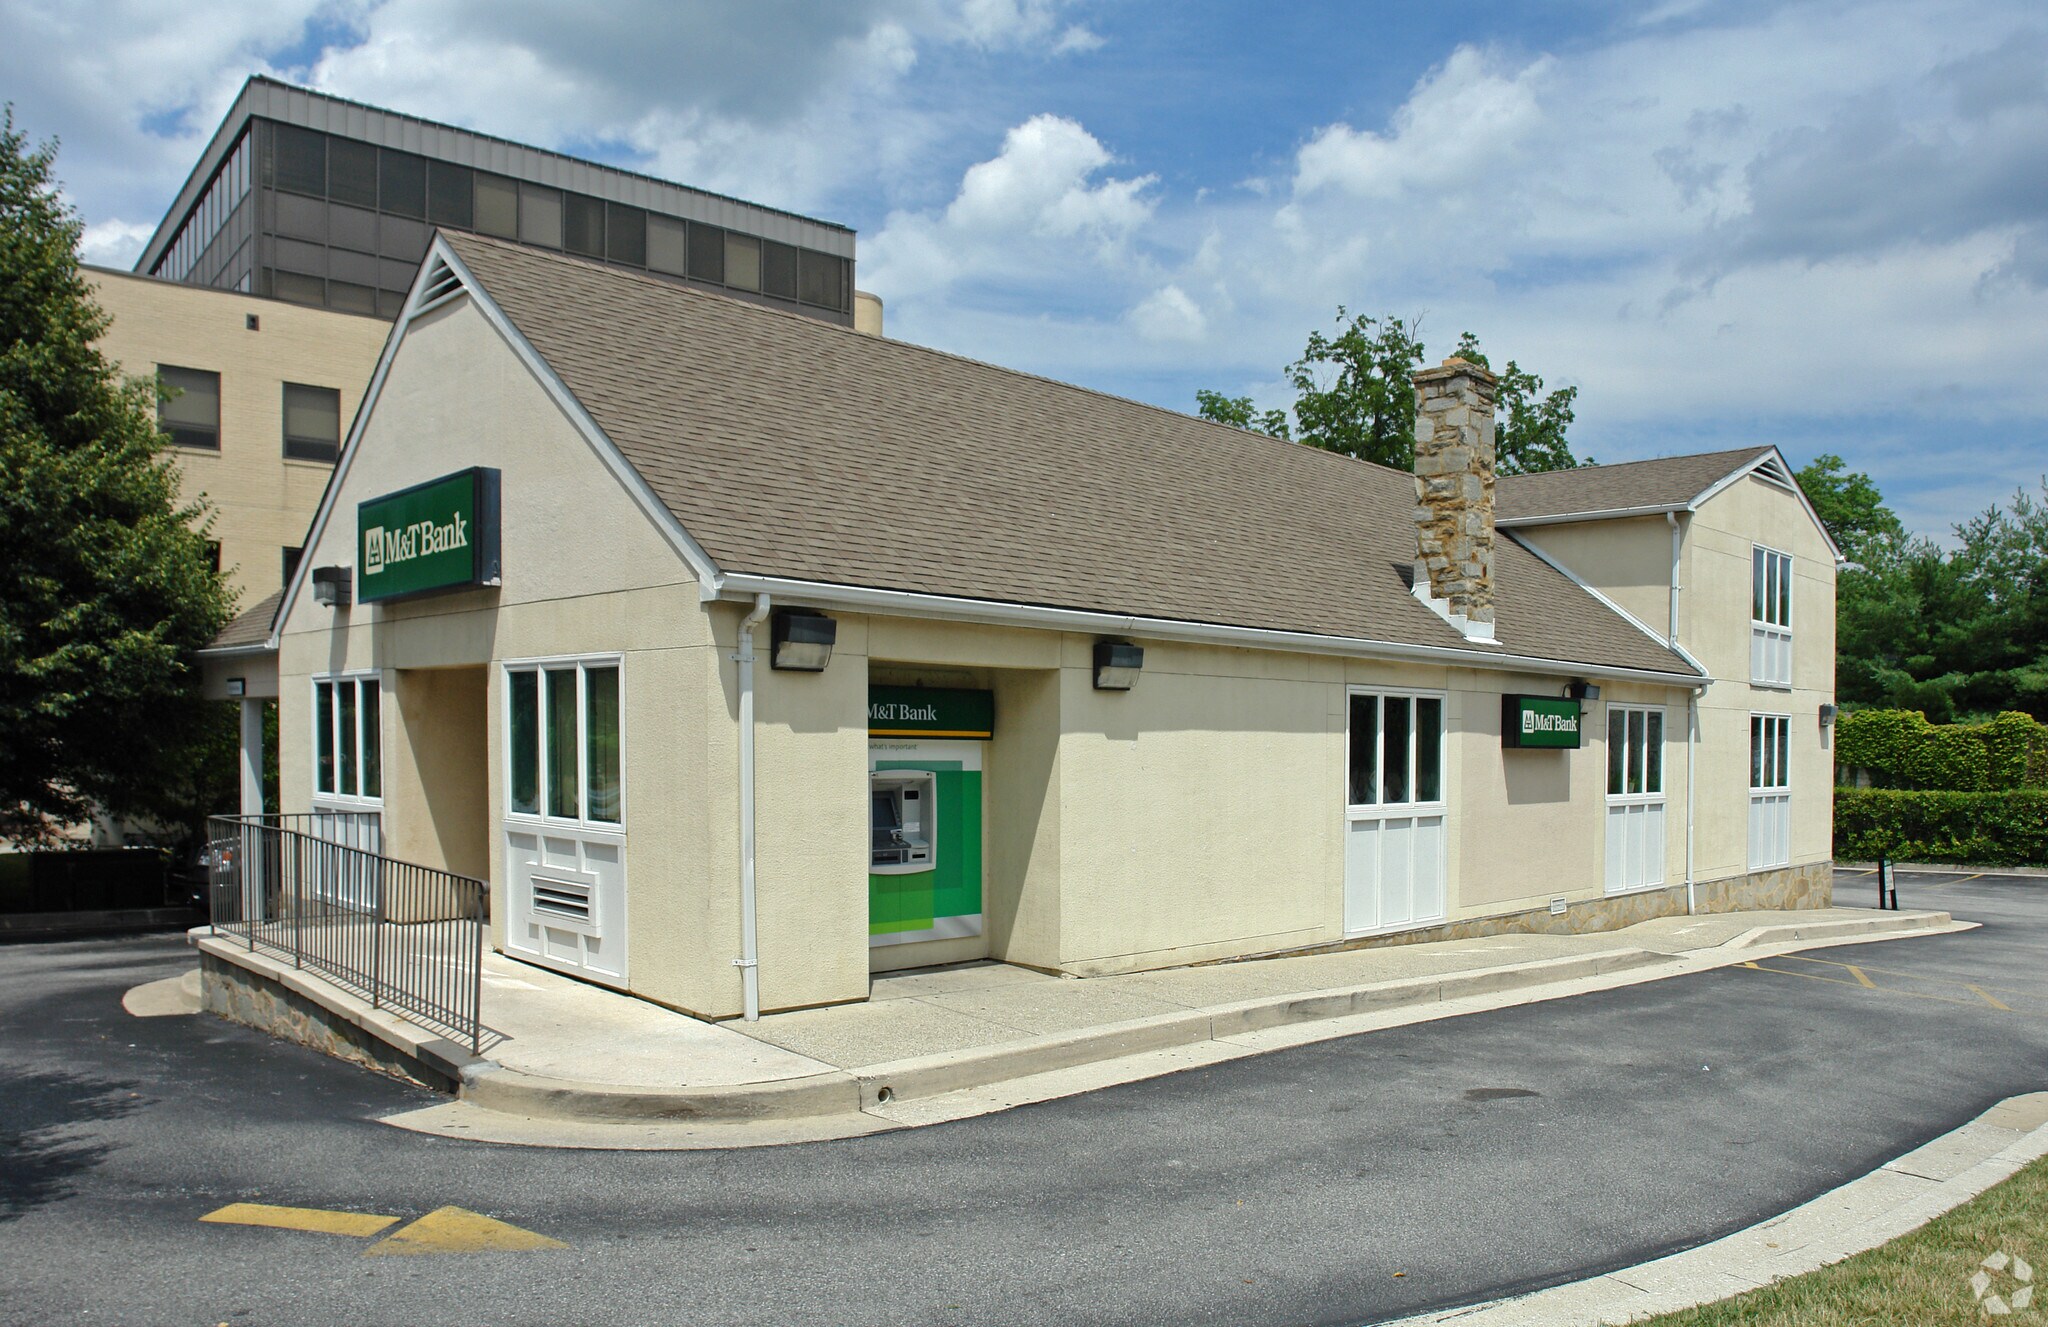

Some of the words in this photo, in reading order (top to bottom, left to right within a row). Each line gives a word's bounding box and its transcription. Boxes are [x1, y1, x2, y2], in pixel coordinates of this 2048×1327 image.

[385, 523, 420, 564] M&T
[420, 511, 468, 556] Bank
[899, 704, 938, 721] Bank
[1534, 714, 1555, 731] M&T
[1554, 715, 1578, 732] Bank
[889, 743, 917, 752] important
